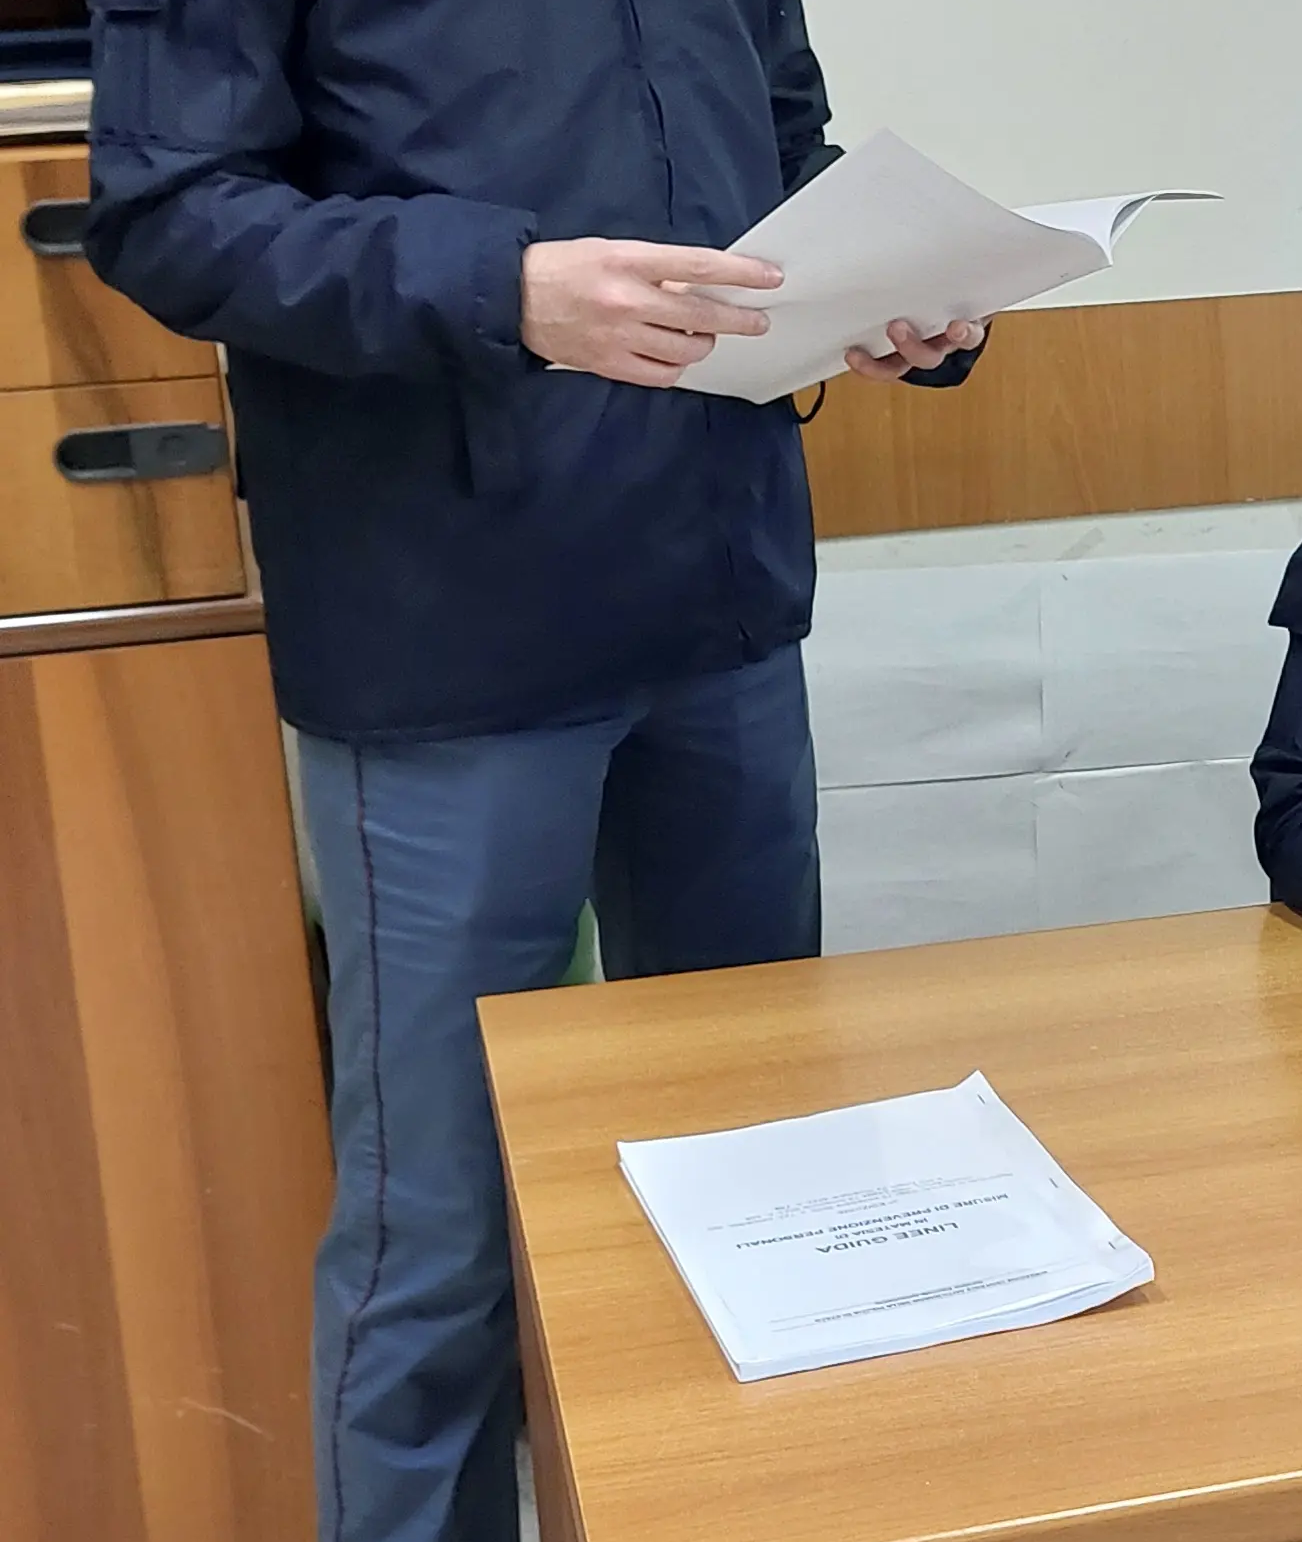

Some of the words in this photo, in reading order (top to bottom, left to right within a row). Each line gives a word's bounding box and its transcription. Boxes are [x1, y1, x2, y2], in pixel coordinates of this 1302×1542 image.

[934, 1205, 950, 1213] DI
[952, 1192, 1009, 1209] MISURE
[828, 1209, 931, 1233] PREVENZIONE
[913, 1217, 928, 1226] IN
[735, 1228, 824, 1250] PERSONALI
[893, 1222, 959, 1240] LINEE
[815, 1236, 889, 1254] GUIDA
